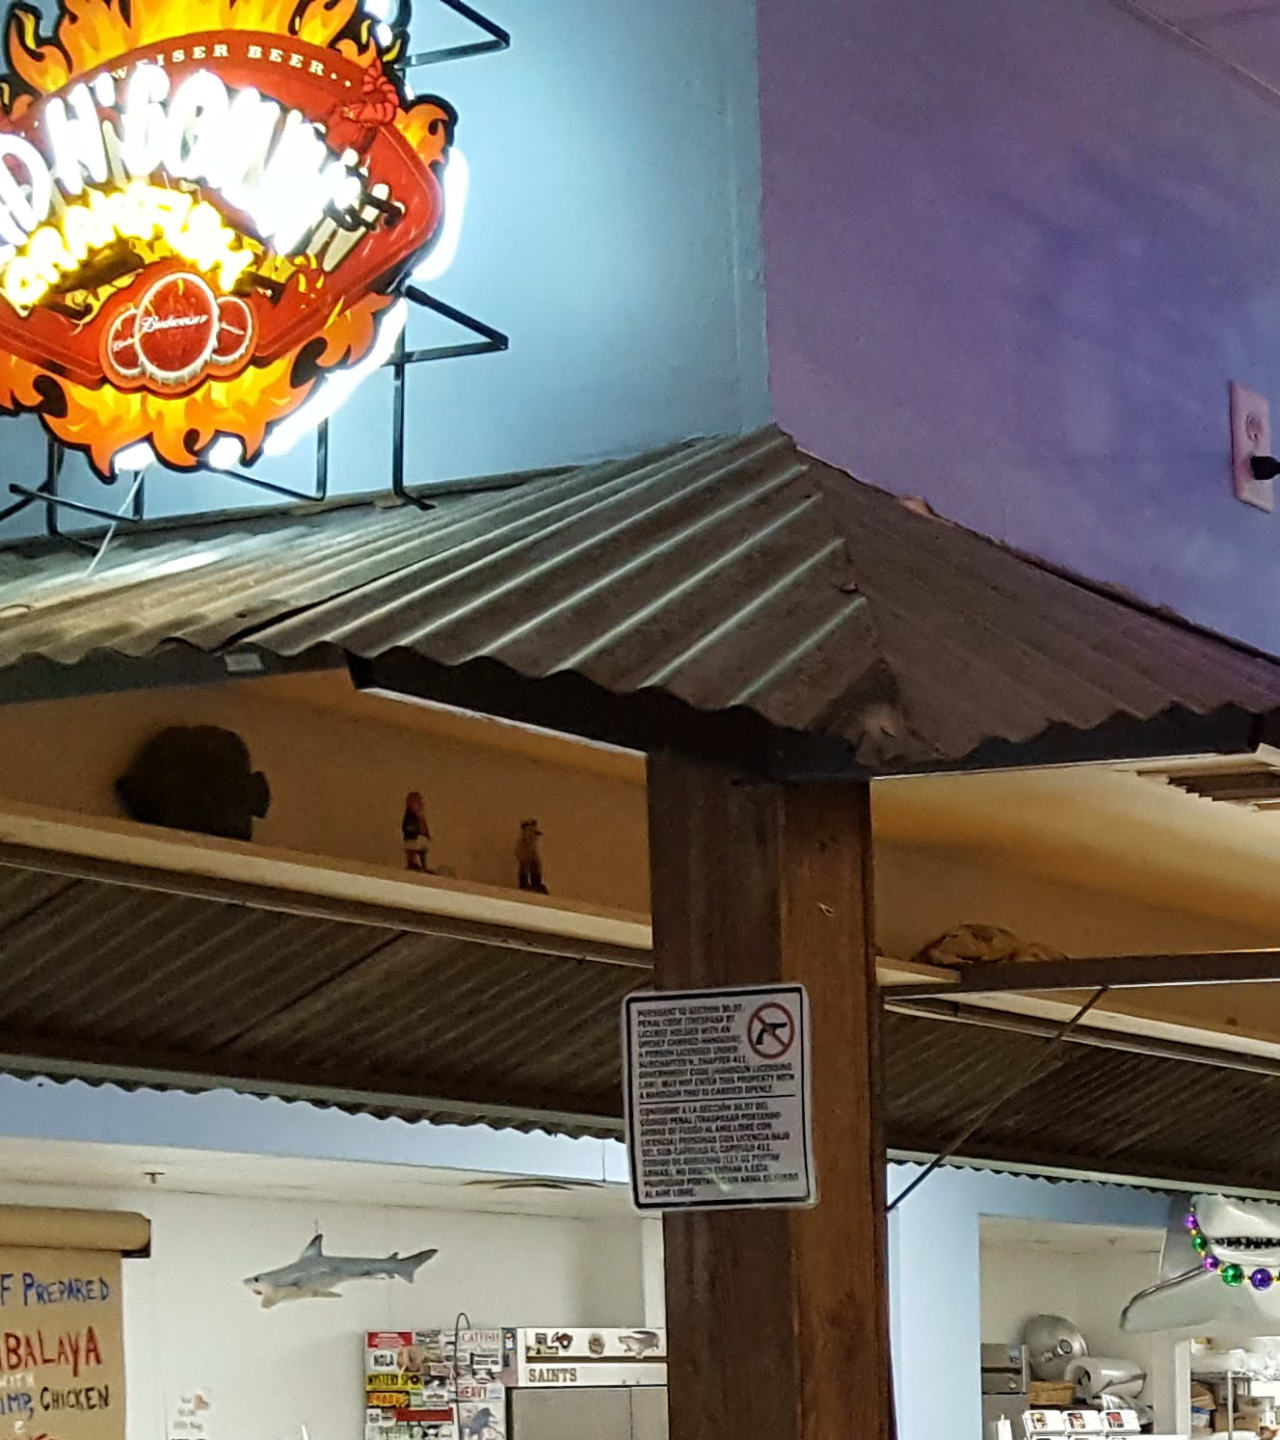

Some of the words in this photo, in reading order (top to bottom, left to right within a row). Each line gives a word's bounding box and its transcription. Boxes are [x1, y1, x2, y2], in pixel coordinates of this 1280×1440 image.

[22, 1272, 109, 1306] PREPARED
[0, 1325, 103, 1378] BALAYA
[528, 1367, 578, 1383] SAINTS
[40, 1384, 109, 1412] CHICKEN
